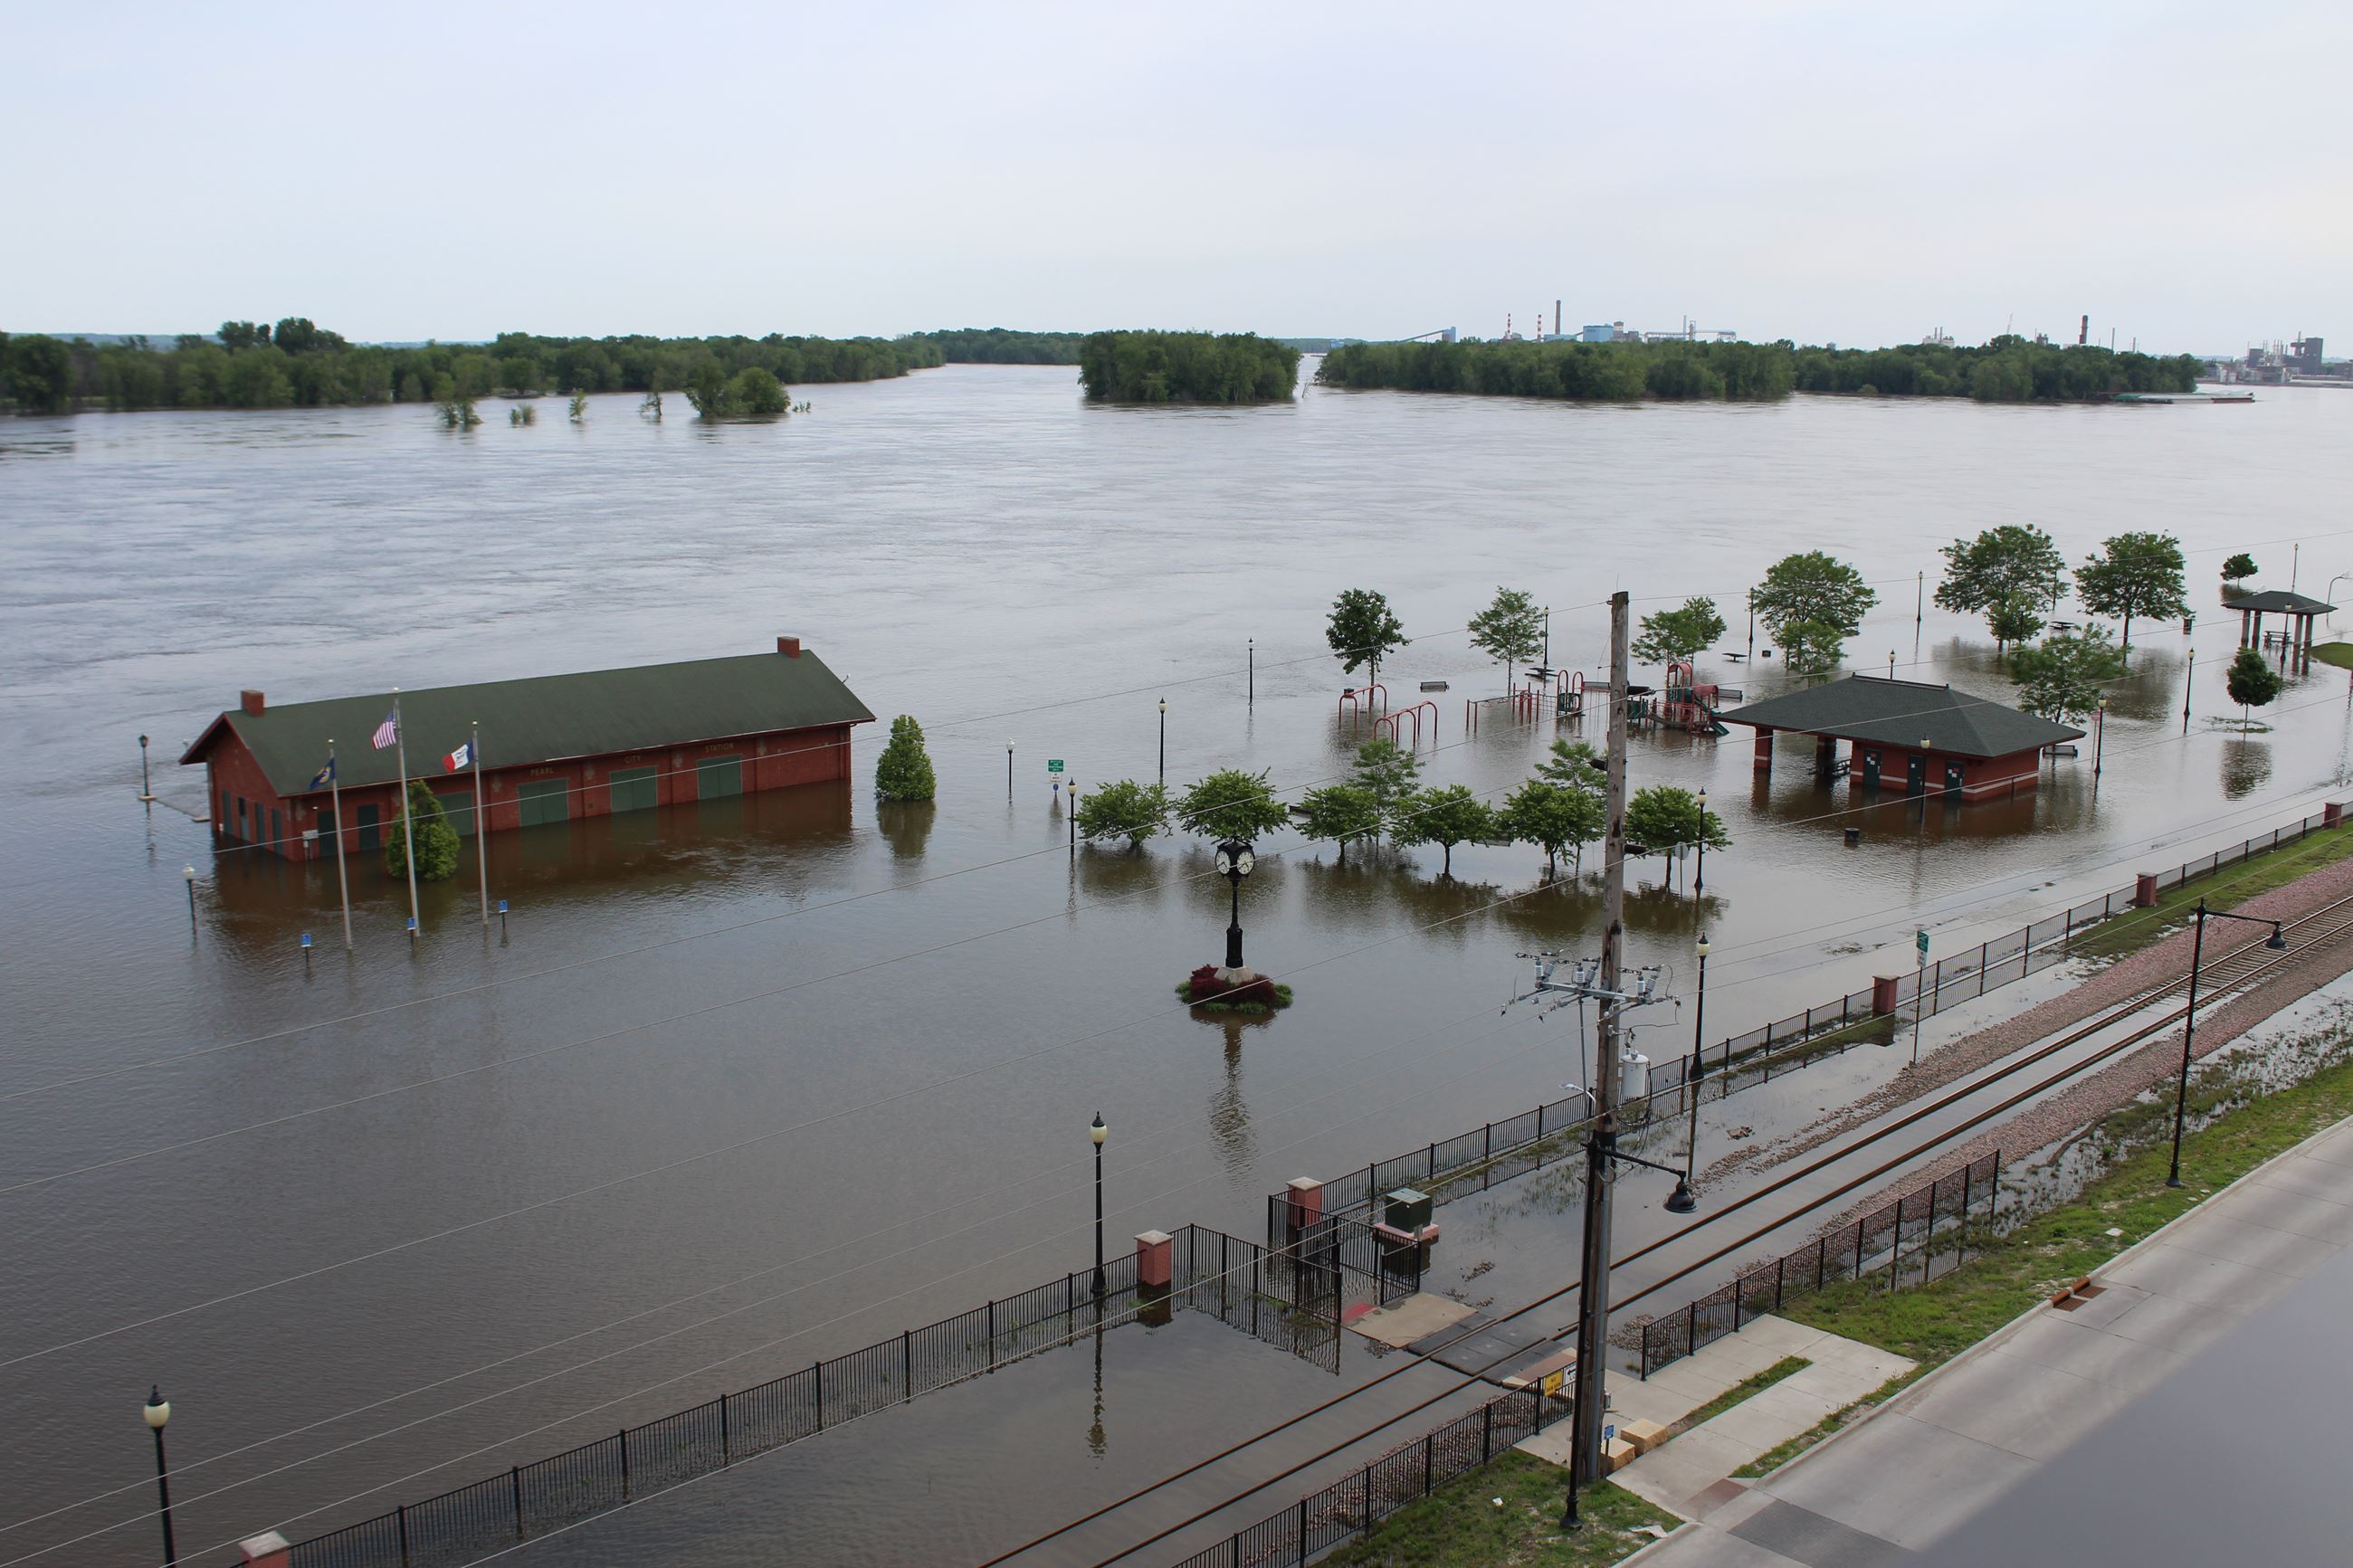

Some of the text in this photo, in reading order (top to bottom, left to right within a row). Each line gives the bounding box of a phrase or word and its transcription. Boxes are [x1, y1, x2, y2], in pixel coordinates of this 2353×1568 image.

[529, 742, 733, 776] PEARL CITY STATION
